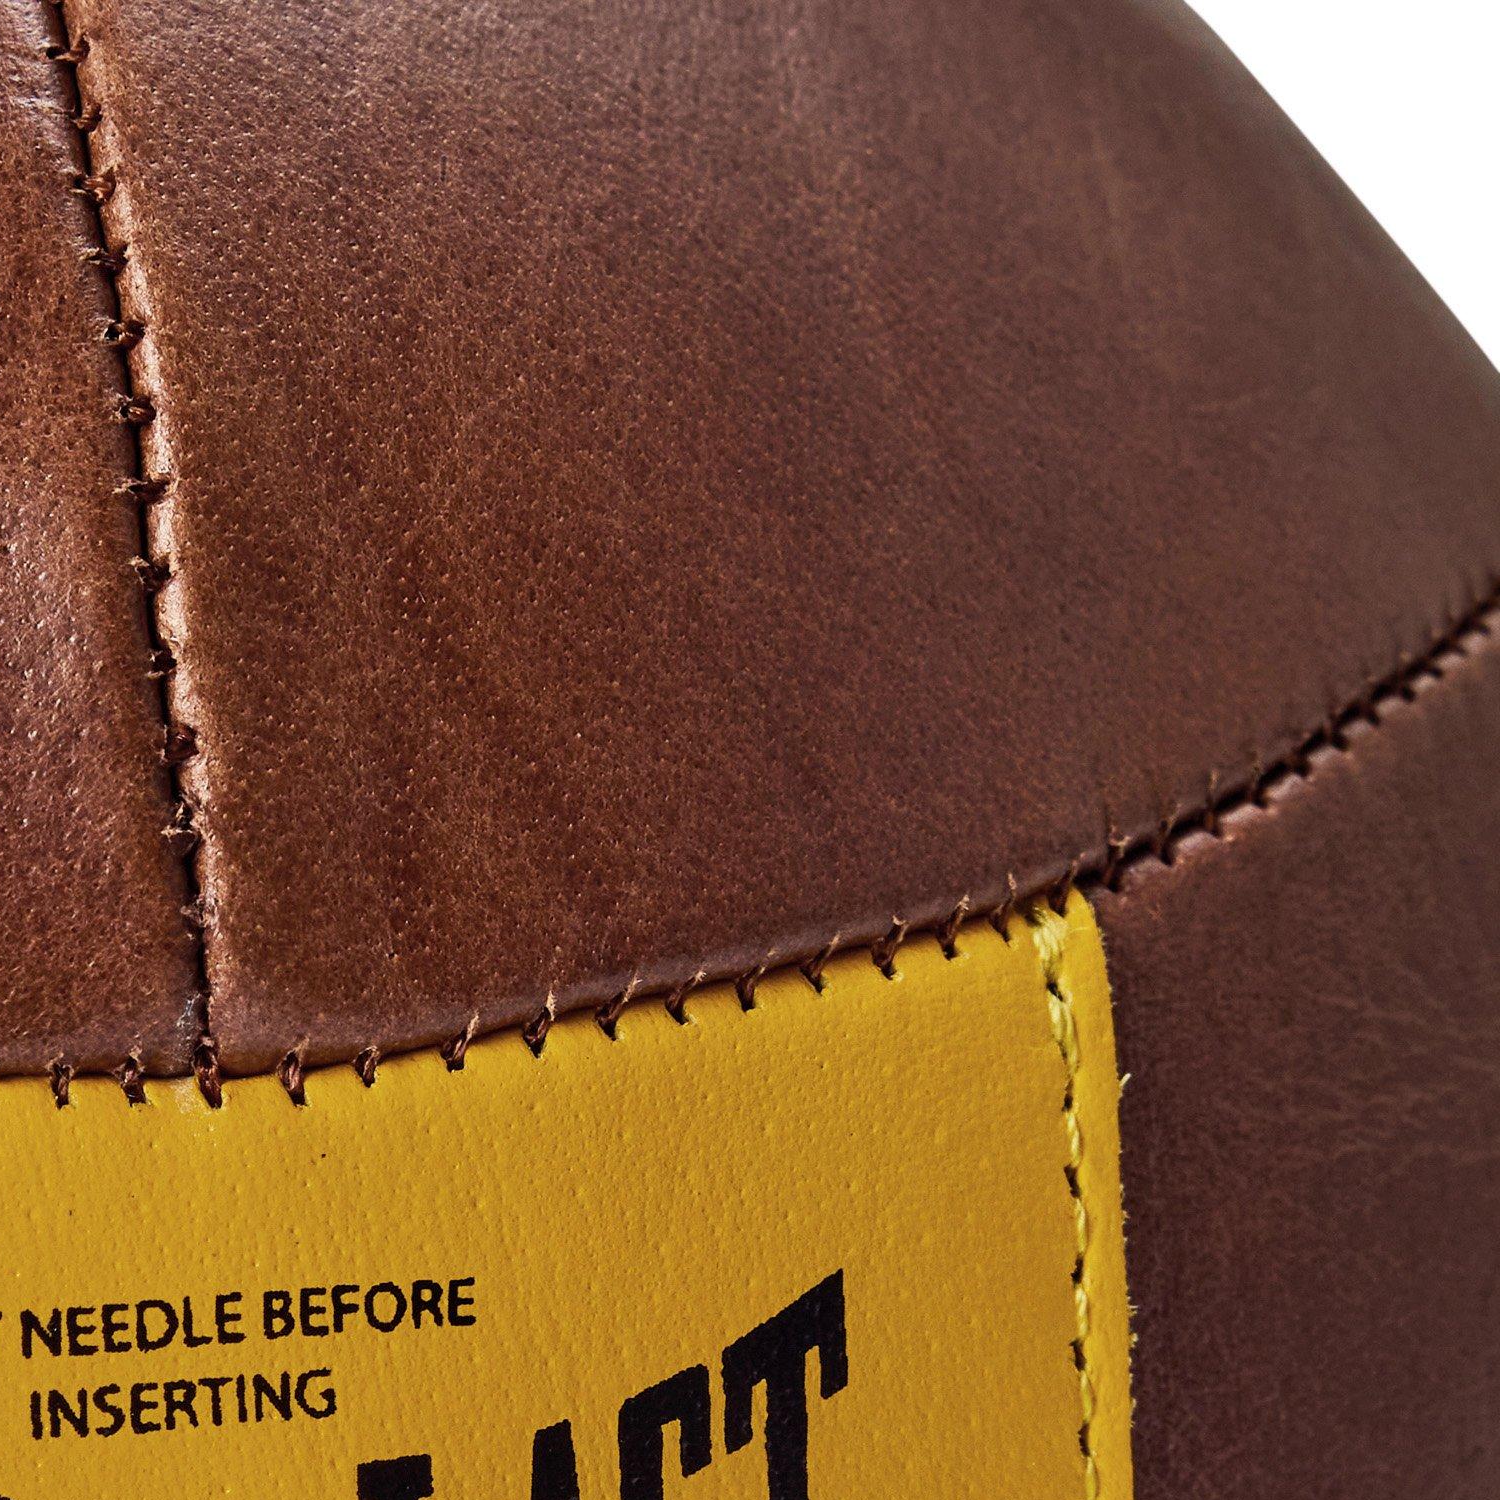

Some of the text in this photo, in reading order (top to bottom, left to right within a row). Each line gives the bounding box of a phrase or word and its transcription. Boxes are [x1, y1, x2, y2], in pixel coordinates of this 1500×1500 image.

[19, 1290, 246, 1360] NEEDLE
[262, 1276, 477, 1341] BEFORE
[29, 1366, 338, 1441] INSERTING
